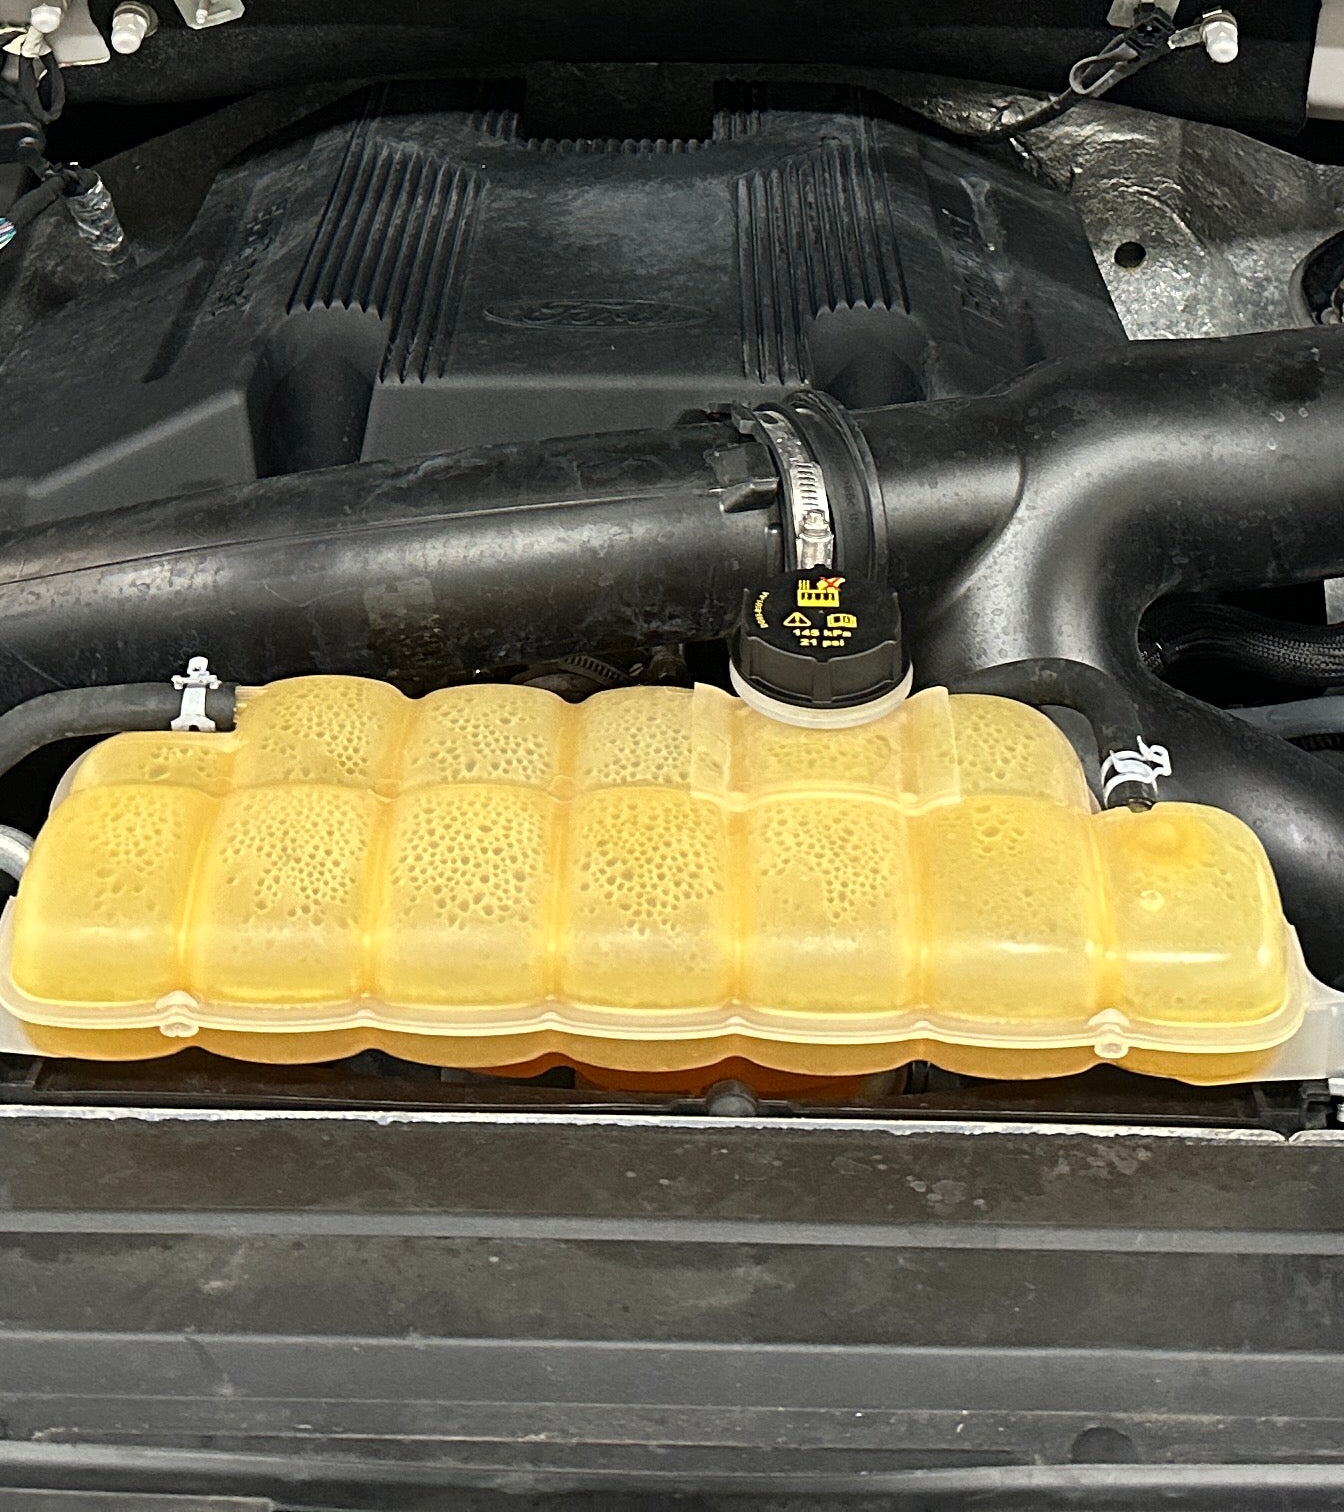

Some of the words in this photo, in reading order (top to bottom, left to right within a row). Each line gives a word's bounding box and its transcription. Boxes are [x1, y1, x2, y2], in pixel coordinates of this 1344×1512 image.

[792, 628, 820, 637] 145
[823, 628, 852, 638] kPa
[799, 638, 818, 647] 21
[822, 638, 845, 648] psi
